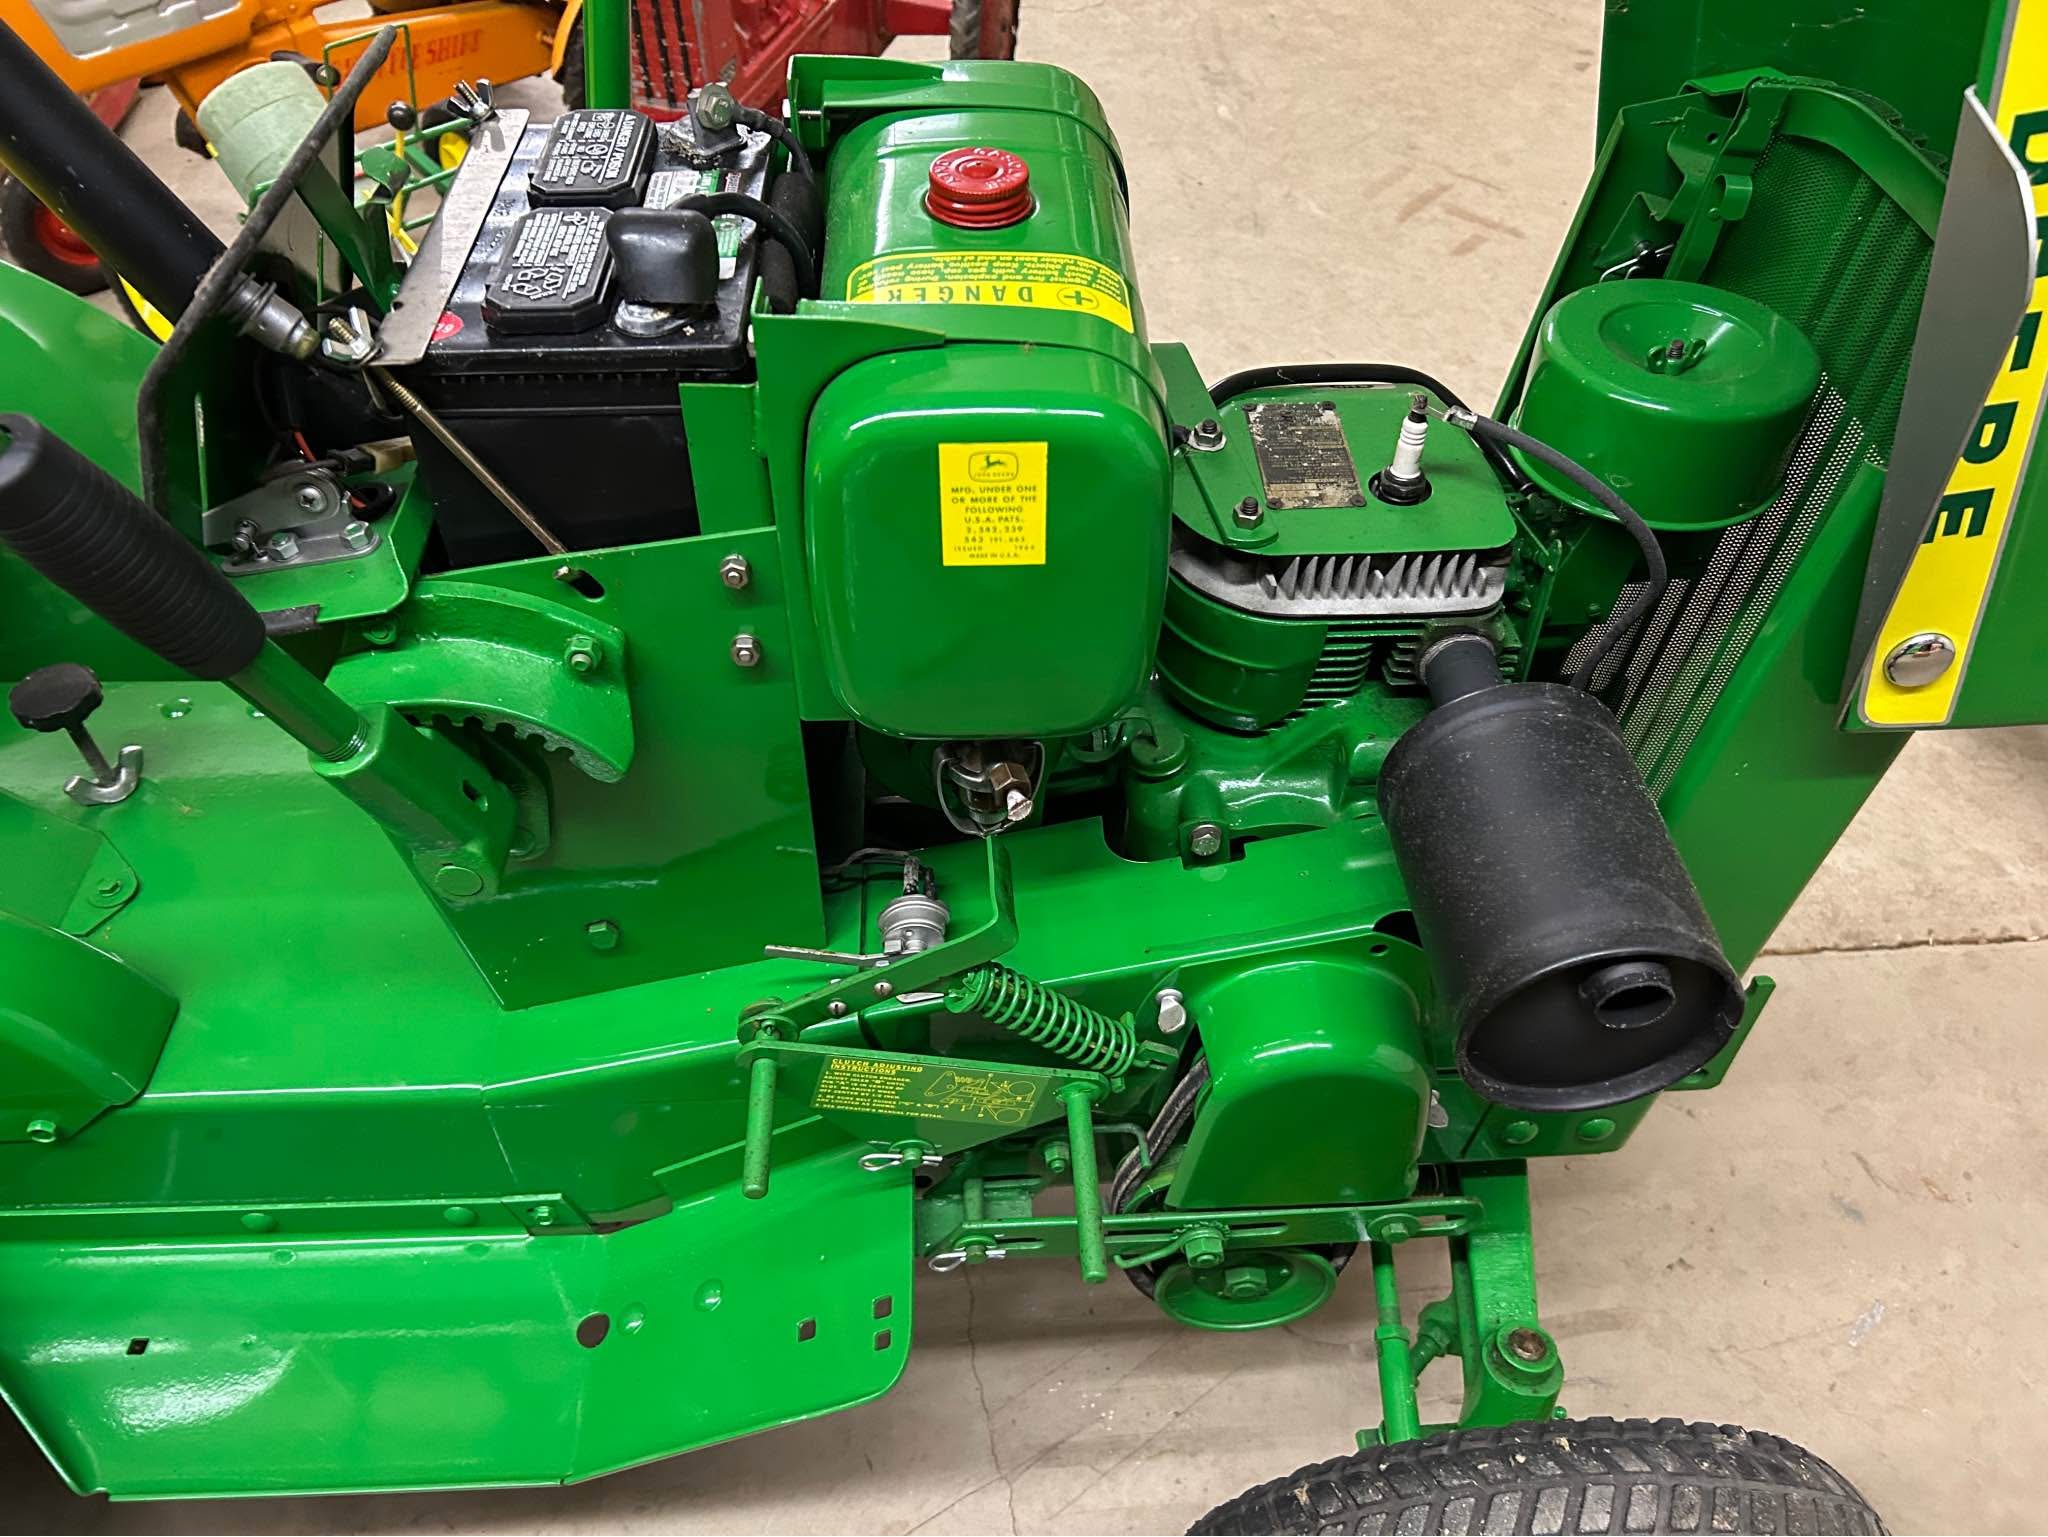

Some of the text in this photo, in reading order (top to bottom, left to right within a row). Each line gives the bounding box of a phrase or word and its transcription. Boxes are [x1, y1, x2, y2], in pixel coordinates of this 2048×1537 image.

[425, 29, 483, 65] SHIFT
[615, 120, 636, 148] DANGER
[888, 286, 1033, 303] DANGER
[980, 486, 1012, 494] UNDER
[1016, 485, 1036, 493] ONE
[951, 496, 965, 504] OR
[1002, 495, 1015, 503] OF
[965, 506, 1023, 514] FOLLOWING
[831, 1064, 897, 1075] INSTRUCTIONS
[832, 1058, 923, 1072] CLUTCH ADJUSTING
